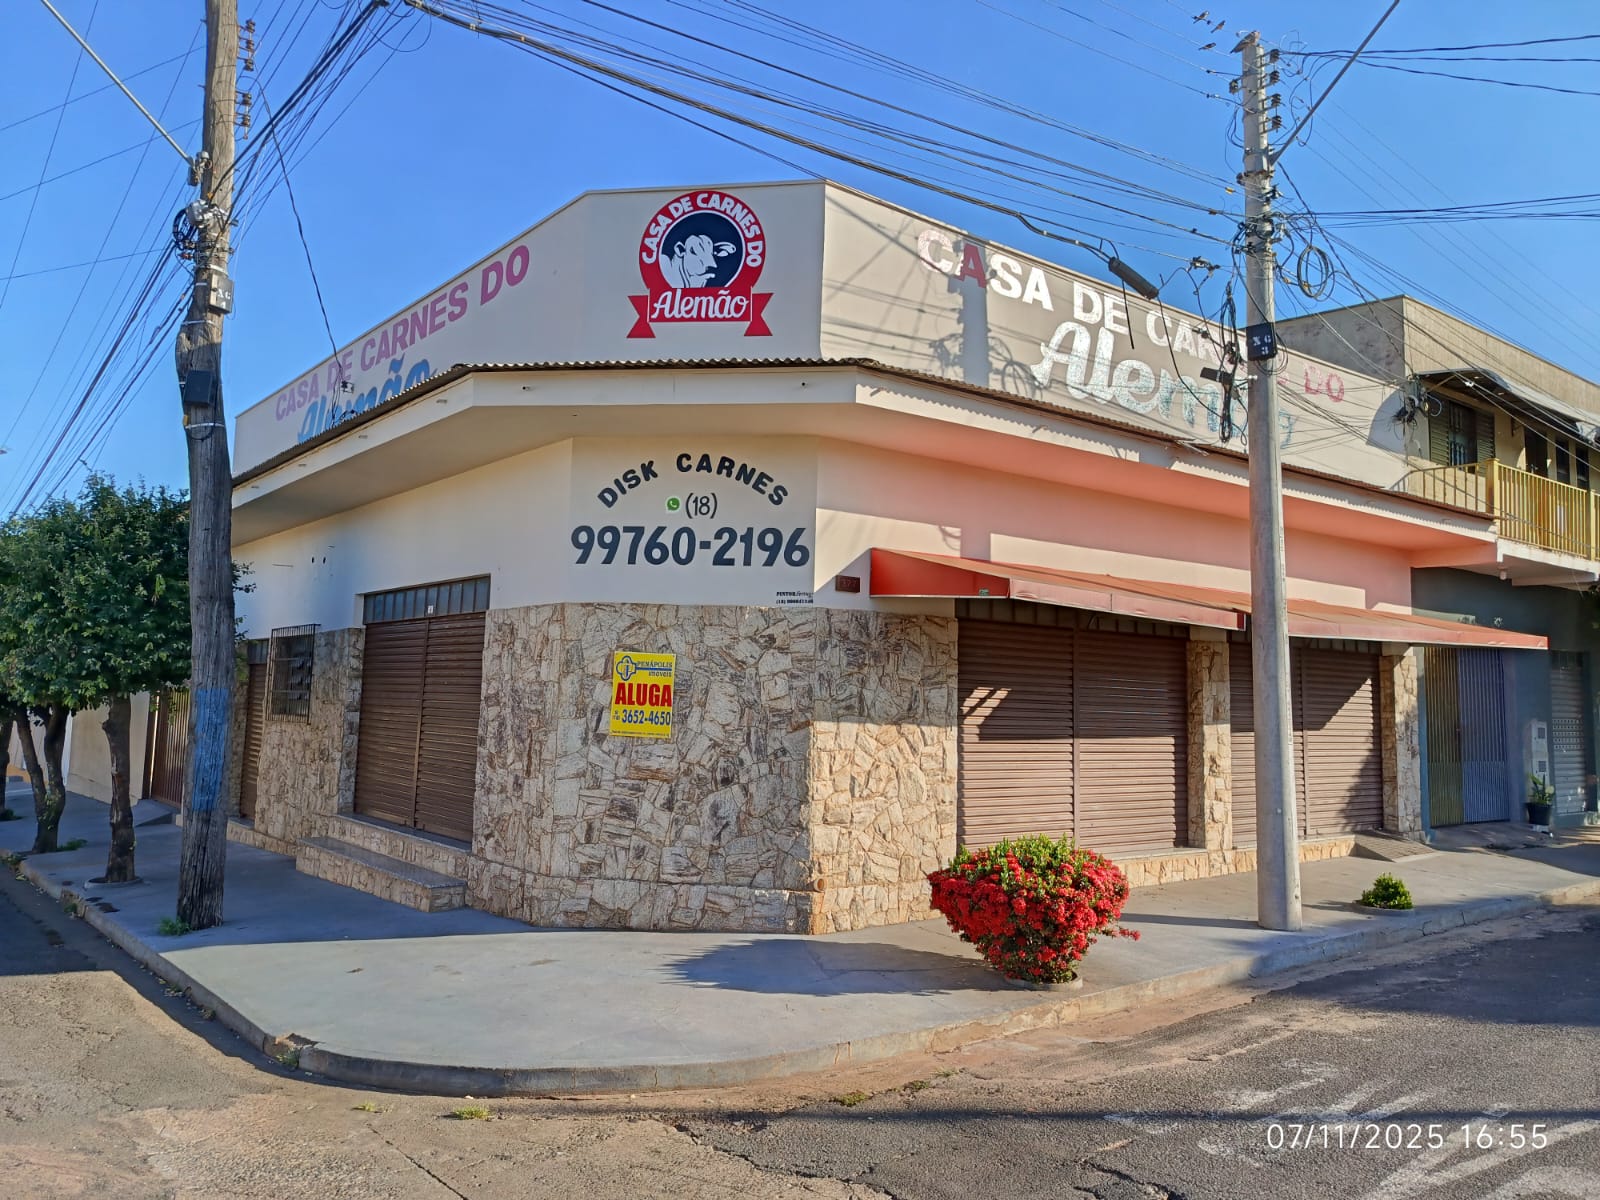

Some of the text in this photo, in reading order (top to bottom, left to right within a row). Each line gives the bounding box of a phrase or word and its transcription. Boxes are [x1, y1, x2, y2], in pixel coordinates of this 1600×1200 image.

[642, 193, 763, 267] CASA DE CARNES DO
[651, 288, 749, 319] Alemão
[918, 230, 1053, 311] CASA
[1073, 281, 1128, 336] DE
[1304, 363, 1344, 403] DO
[275, 245, 530, 421] CASA DE CARNES DO
[597, 453, 788, 508] DISK CARNES
[685, 492, 718, 519] (18)
[571, 525, 810, 567] 99760-2196
[614, 682, 672, 707] ALUGA
[622, 708, 671, 725] 3652-4650
